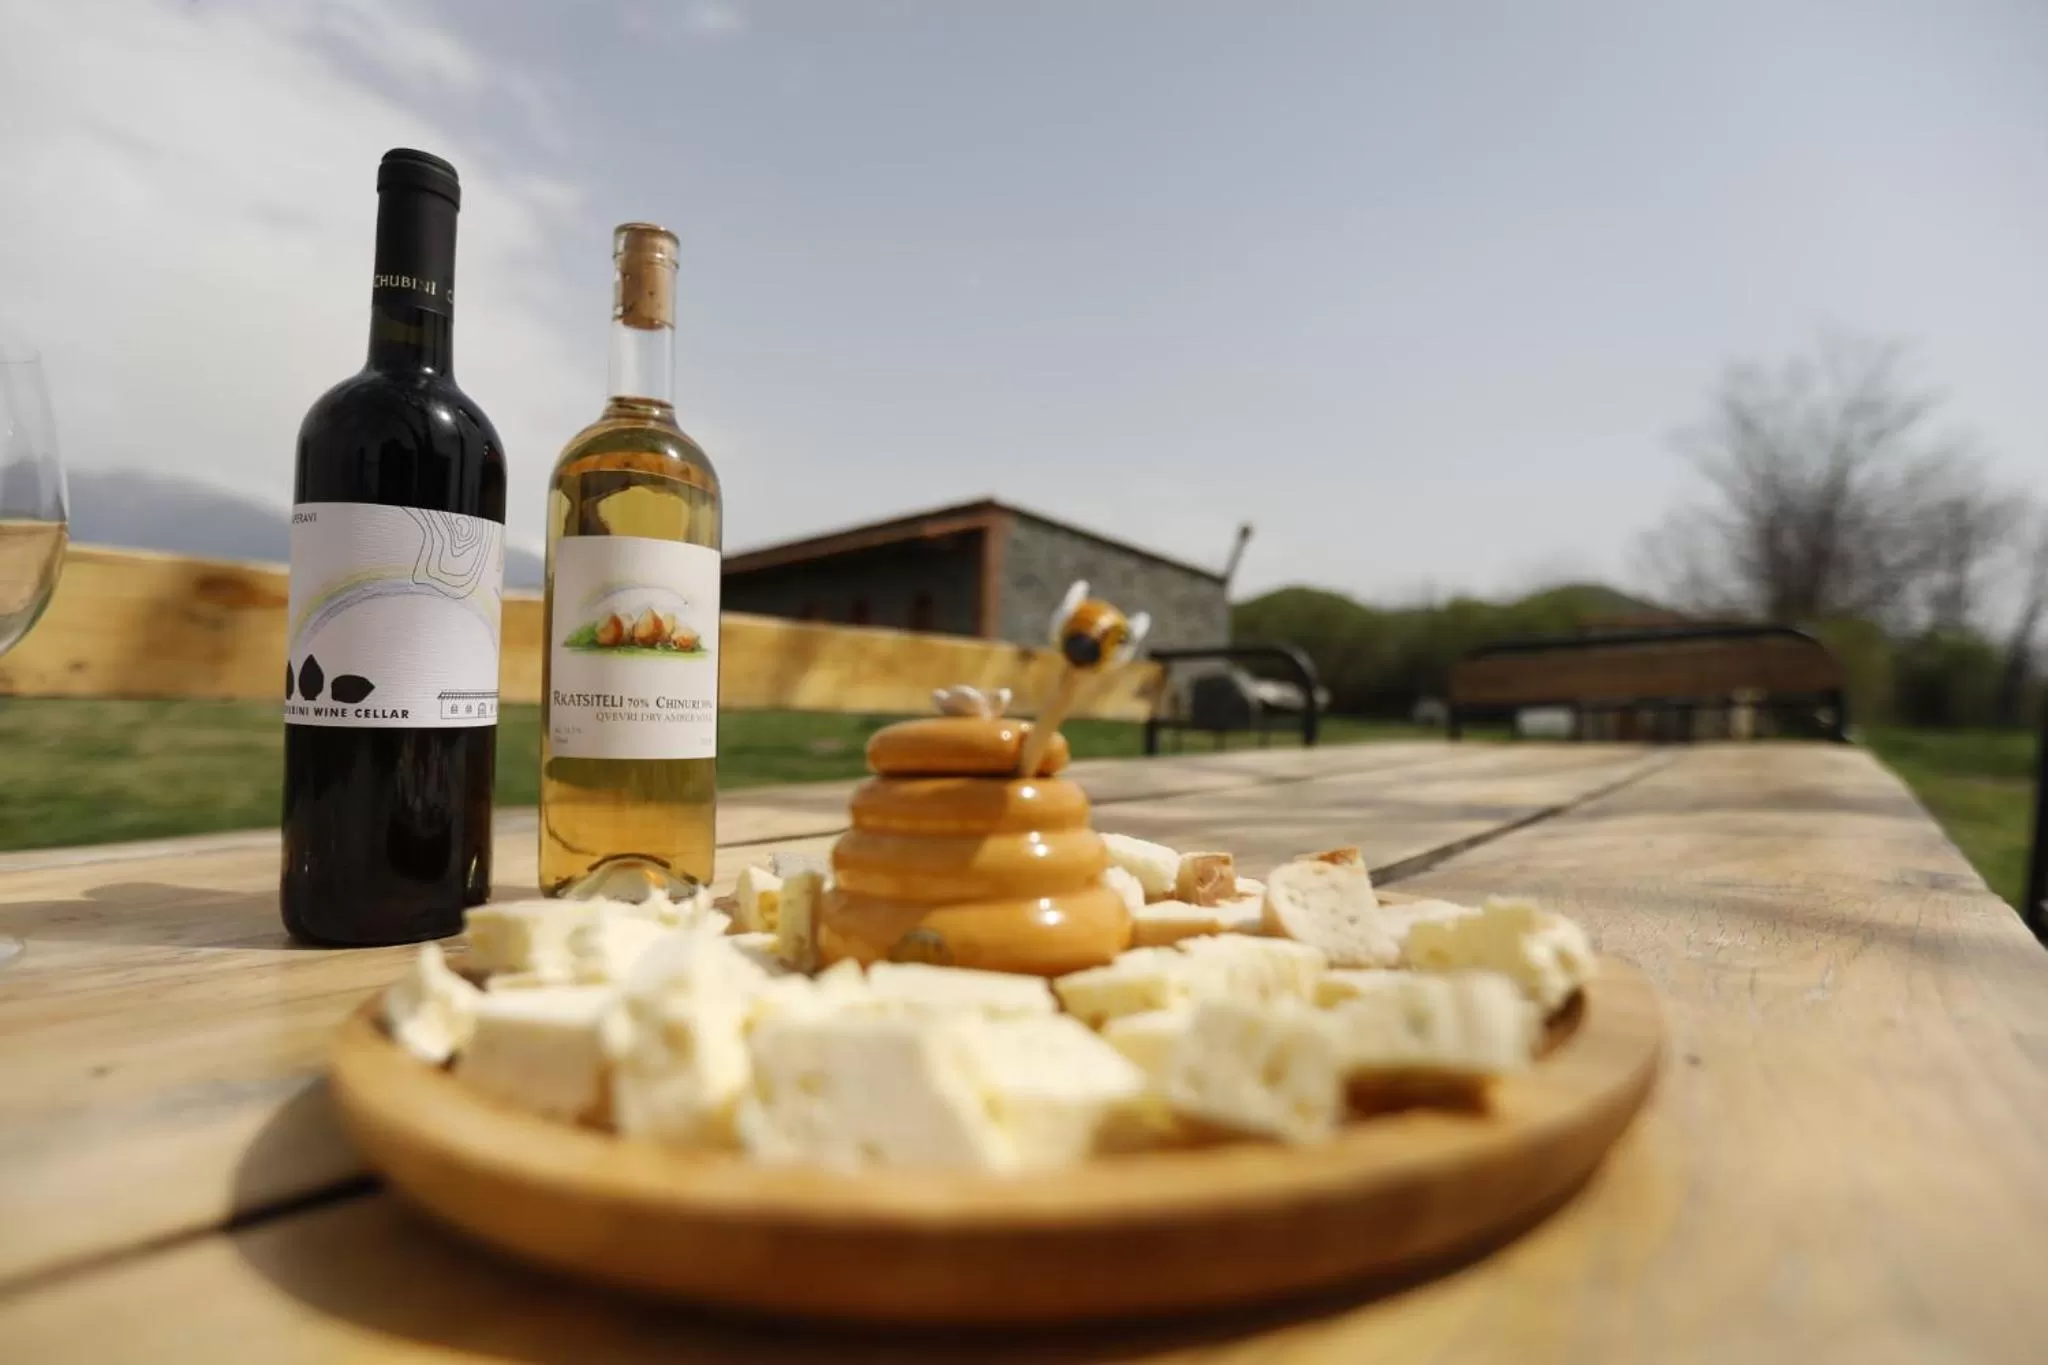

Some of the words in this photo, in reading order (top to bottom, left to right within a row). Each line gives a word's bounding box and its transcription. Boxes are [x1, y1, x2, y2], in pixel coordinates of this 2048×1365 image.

[627, 698, 650, 709] 70%
[314, 707, 348, 718] WINE
[355, 708, 410, 719] CELLAR
